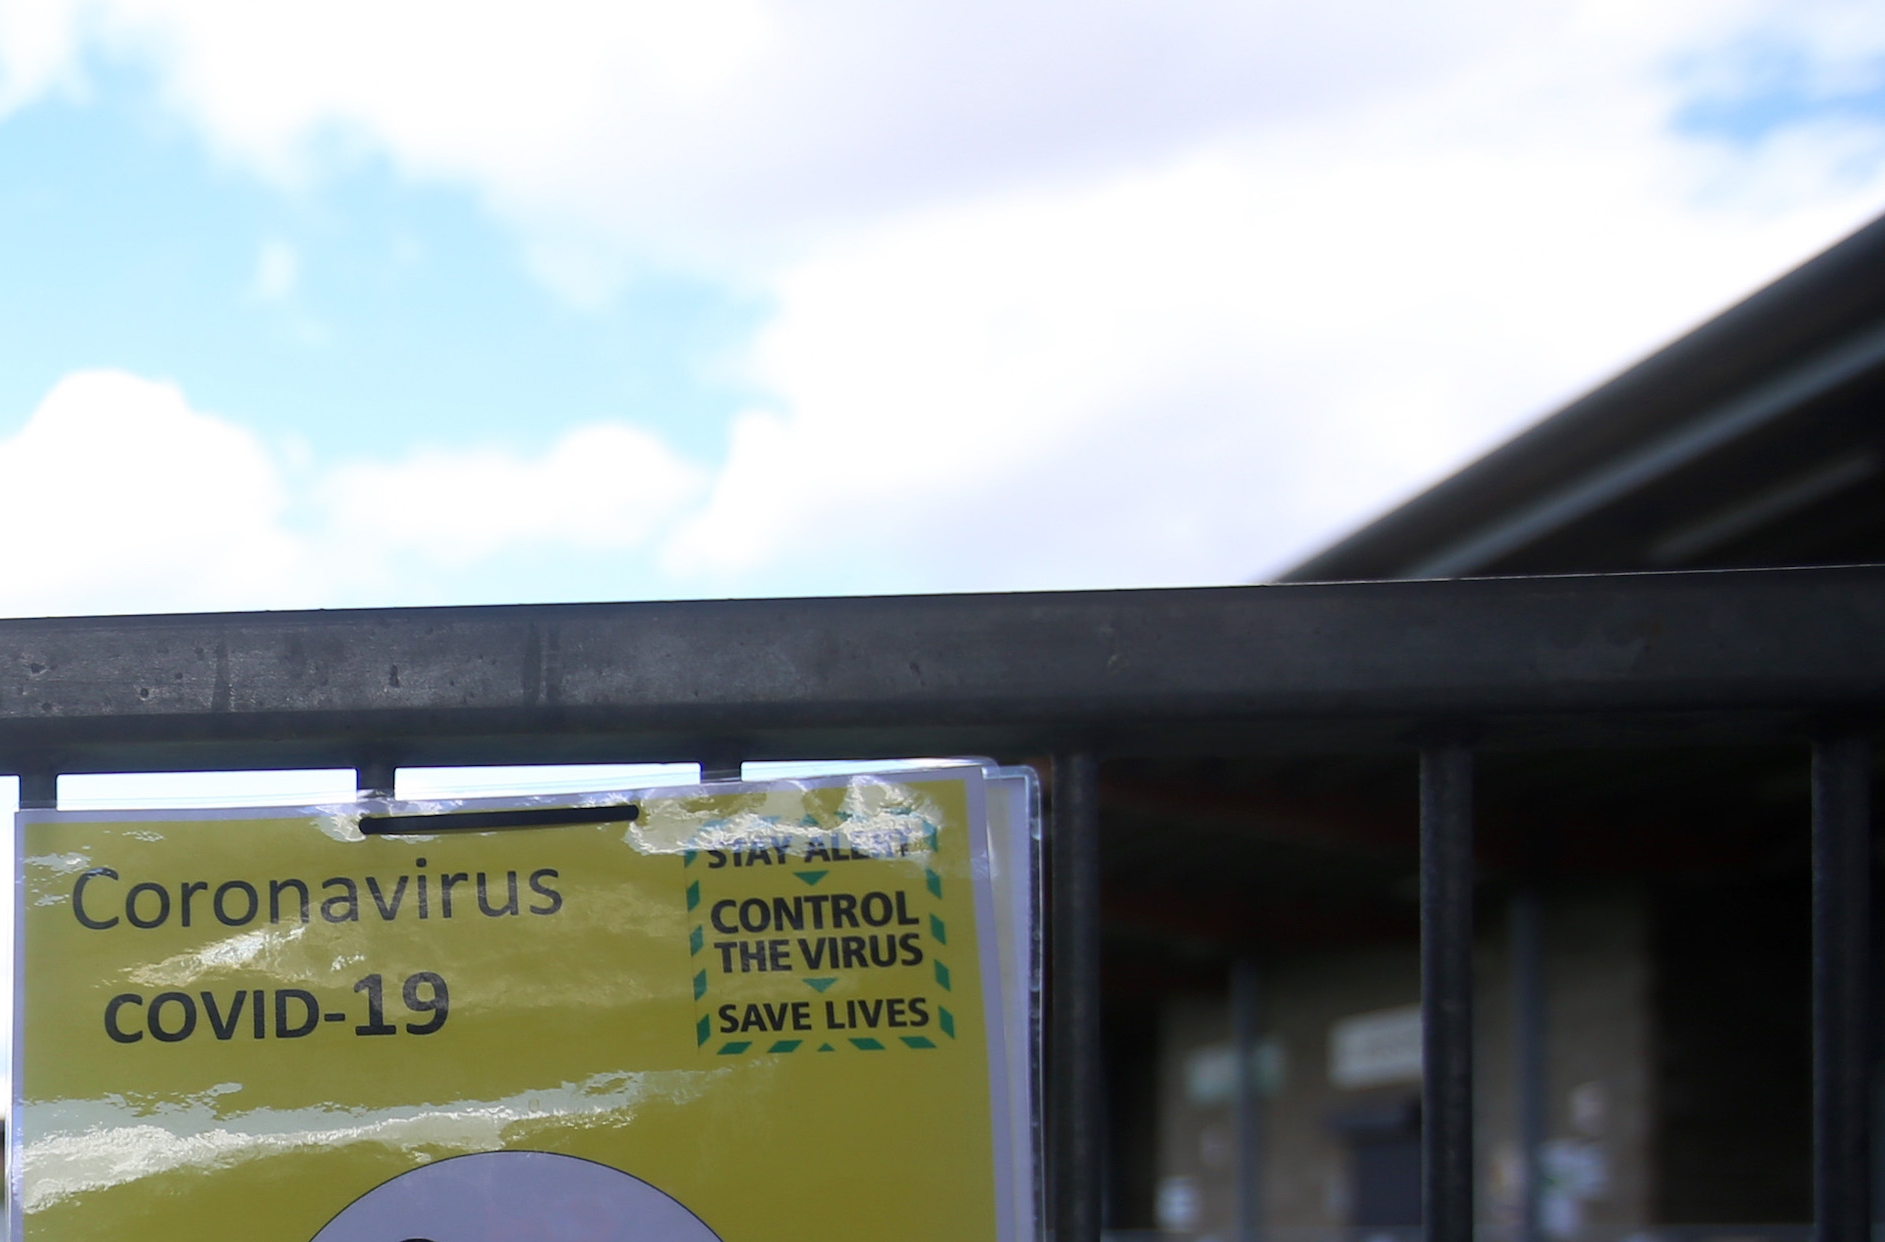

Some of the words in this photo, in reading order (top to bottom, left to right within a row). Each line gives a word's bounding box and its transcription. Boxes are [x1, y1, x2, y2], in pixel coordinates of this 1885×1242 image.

[707, 836, 794, 869] STAY
[71, 857, 564, 931] Coronavirus
[710, 891, 920, 934] CONTROL
[714, 938, 792, 973] THE
[797, 932, 923, 970] VIRUS
[103, 970, 450, 1044] COVID-19
[717, 1002, 812, 1034] SAVE
[825, 997, 930, 1030] LIVES
